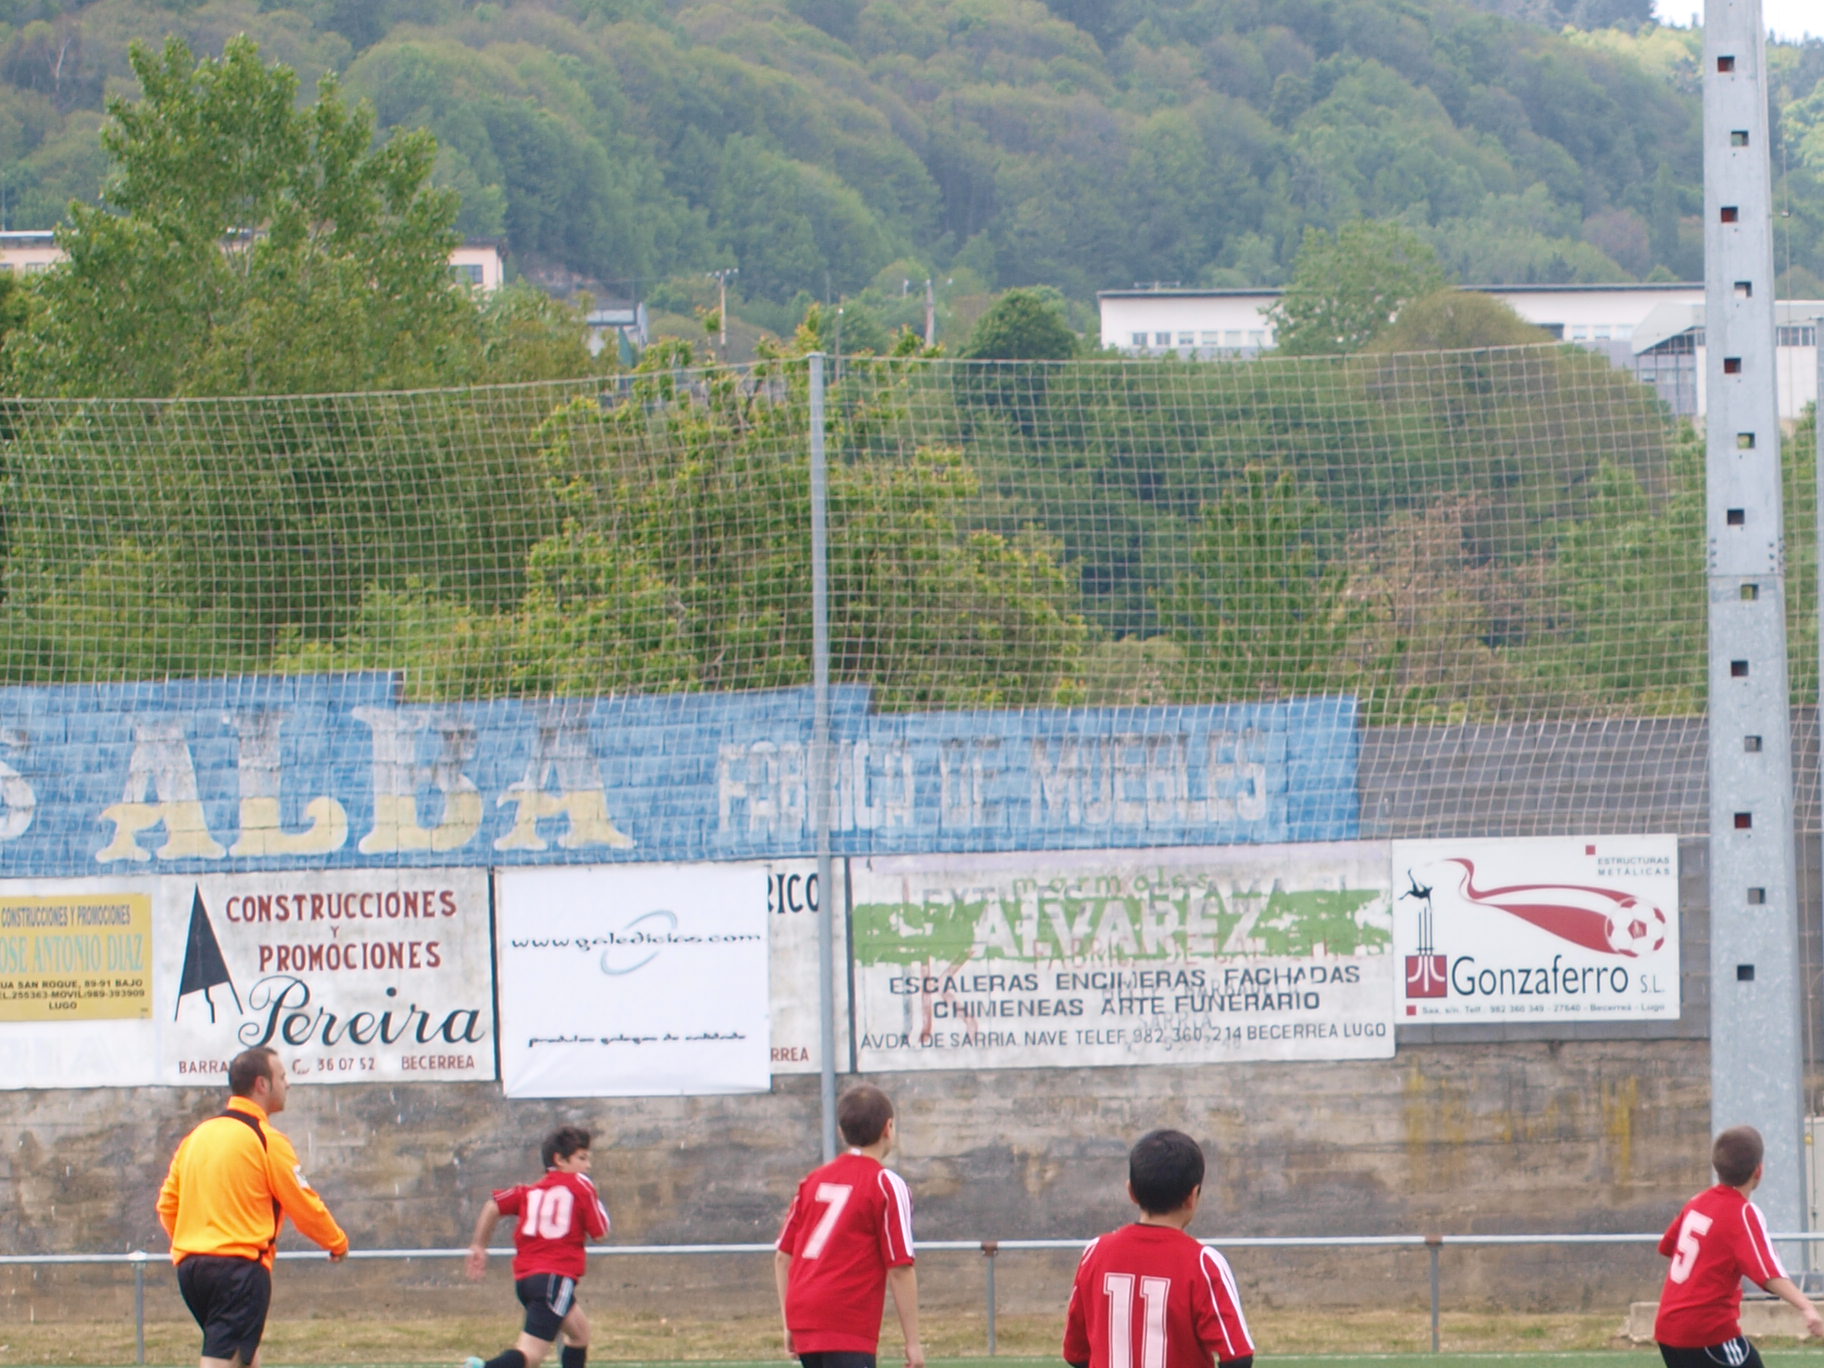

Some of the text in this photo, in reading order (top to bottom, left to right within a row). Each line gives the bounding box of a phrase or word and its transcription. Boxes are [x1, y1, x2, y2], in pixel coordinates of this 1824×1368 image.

[96, 700, 635, 862] ALBA
[1597, 857, 1670, 865] ESTRUCTURAS
[2, 907, 68, 928] CONSTRUCCIONES
[77, 904, 131, 926] PROMOCIONES
[226, 890, 457, 924] CONSTRUCCIONES
[331, 926, 339, 939] Y
[971, 898, 1266, 959] ALVAREZ
[31, 933, 104, 974] ANTONIO
[106, 932, 144, 972] DIAZ
[259, 941, 441, 972] PROMOCIONES
[115, 978, 143, 988] BAJO
[889, 965, 1360, 996] ESCALERAS ENCIMERAS FACHADAS
[1451, 954, 1665, 996] Gonzaferro S.L.
[49, 1001, 77, 1010] LUGO
[238, 976, 486, 1048] Pereira
[933, 991, 1320, 1019] CHIMENEAS ARTE FUNERARIO
[921, 1032, 945, 1048] DE
[951, 1031, 1017, 1048] SARRIA
[1024, 1030, 1069, 1046] NAVE
[1247, 1022, 1338, 1040] BECERREA
[1343, 1021, 1387, 1038] LUGO
[317, 1058, 333, 1071] 36
[338, 1057, 354, 1071] 07
[359, 1056, 376, 1070] 52
[401, 1055, 475, 1070] BECERREA
[521, 1185, 574, 1239] 10
[802, 1183, 852, 1259] 7
[1669, 1209, 1713, 1285] 5
